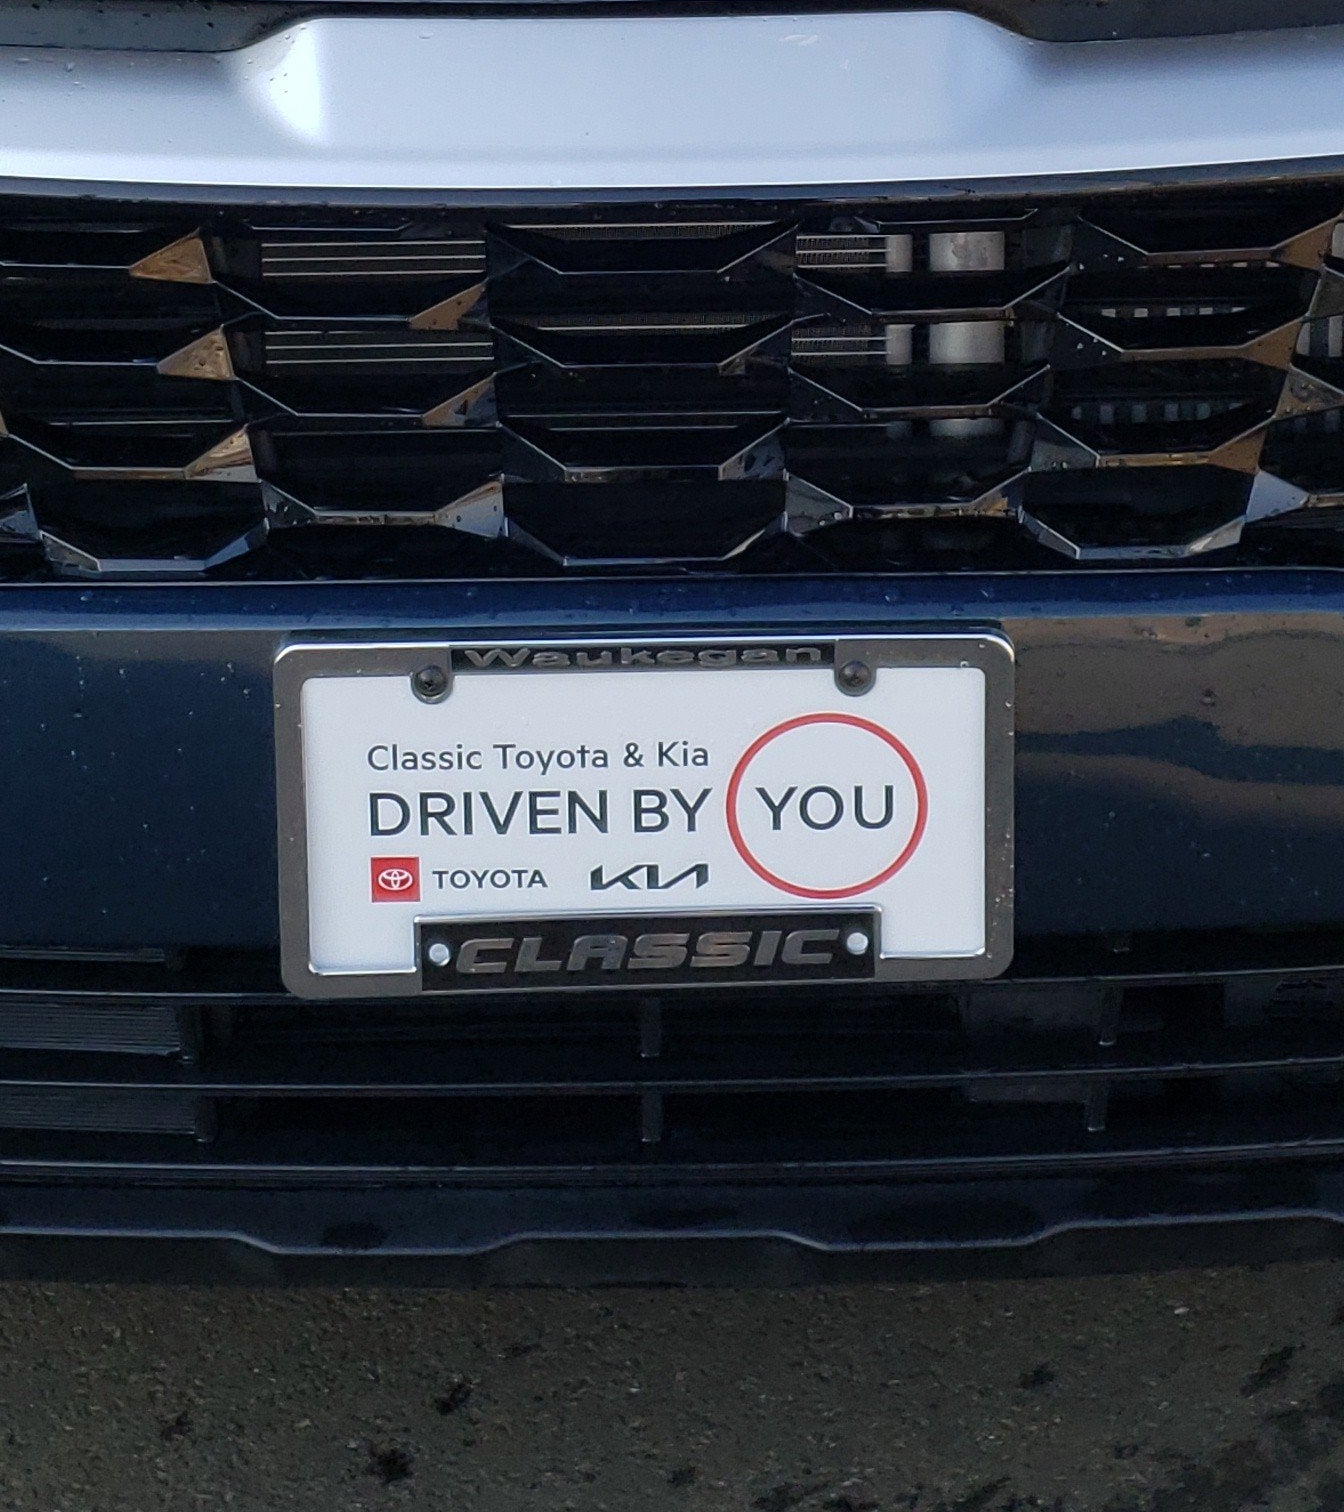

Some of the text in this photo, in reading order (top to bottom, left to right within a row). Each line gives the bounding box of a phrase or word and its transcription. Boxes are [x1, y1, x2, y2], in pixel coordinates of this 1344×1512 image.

[463, 646, 823, 669] Waukegan
[367, 740, 711, 776] Classic Toyota & Kia
[369, 784, 896, 838] DRIVEN BY YOU
[432, 869, 548, 890] TOYOTA
[589, 863, 710, 892] KIA
[456, 928, 842, 976] CLASSIC
